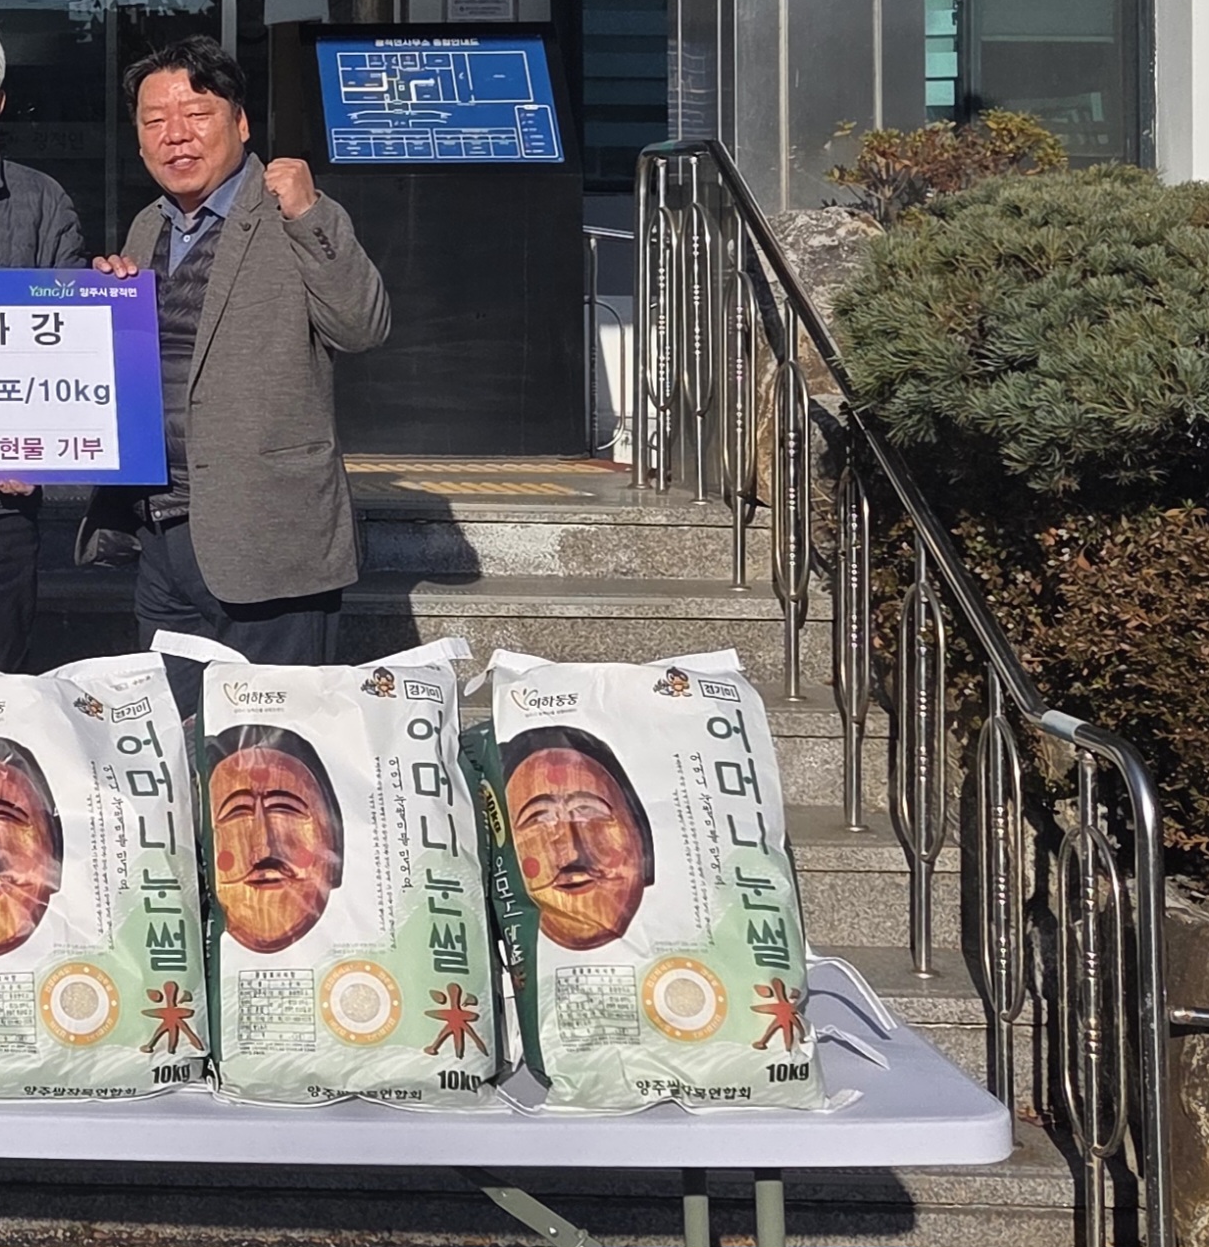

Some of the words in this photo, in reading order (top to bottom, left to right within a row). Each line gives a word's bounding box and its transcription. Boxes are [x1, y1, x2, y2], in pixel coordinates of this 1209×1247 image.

[79, 287, 108, 298] 양주시
[109, 287, 139, 298] 광적면
[57, 437, 104, 461] 기부
[408, 684, 440, 698] 경기미
[704, 683, 737, 700] 경기미
[115, 700, 148, 719] 경기미
[151, 1063, 190, 1084] 10kg
[765, 1061, 810, 1083] 10kg
